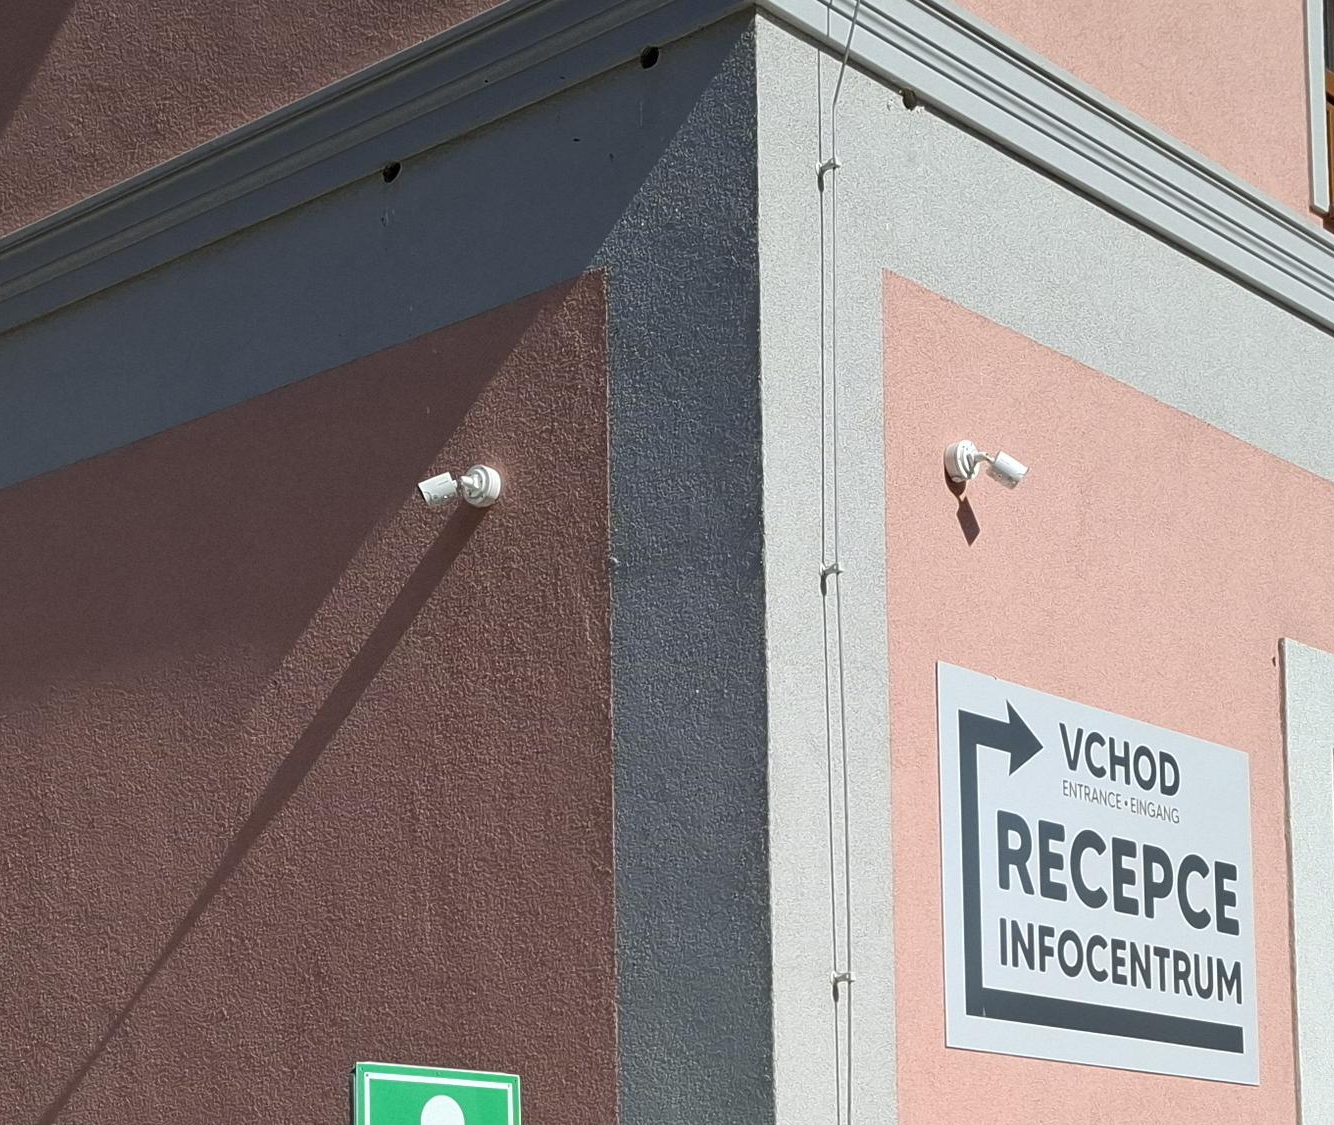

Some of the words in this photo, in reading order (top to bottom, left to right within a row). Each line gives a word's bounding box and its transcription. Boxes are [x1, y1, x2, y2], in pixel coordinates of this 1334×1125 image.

[1059, 722, 1181, 797] VCHOD
[1062, 779, 1122, 810] ENTRANCE
[1130, 797, 1181, 824] EINGANG
[996, 809, 1241, 937] RECEPCE
[999, 917, 1243, 1005] INFOCENTRUM
